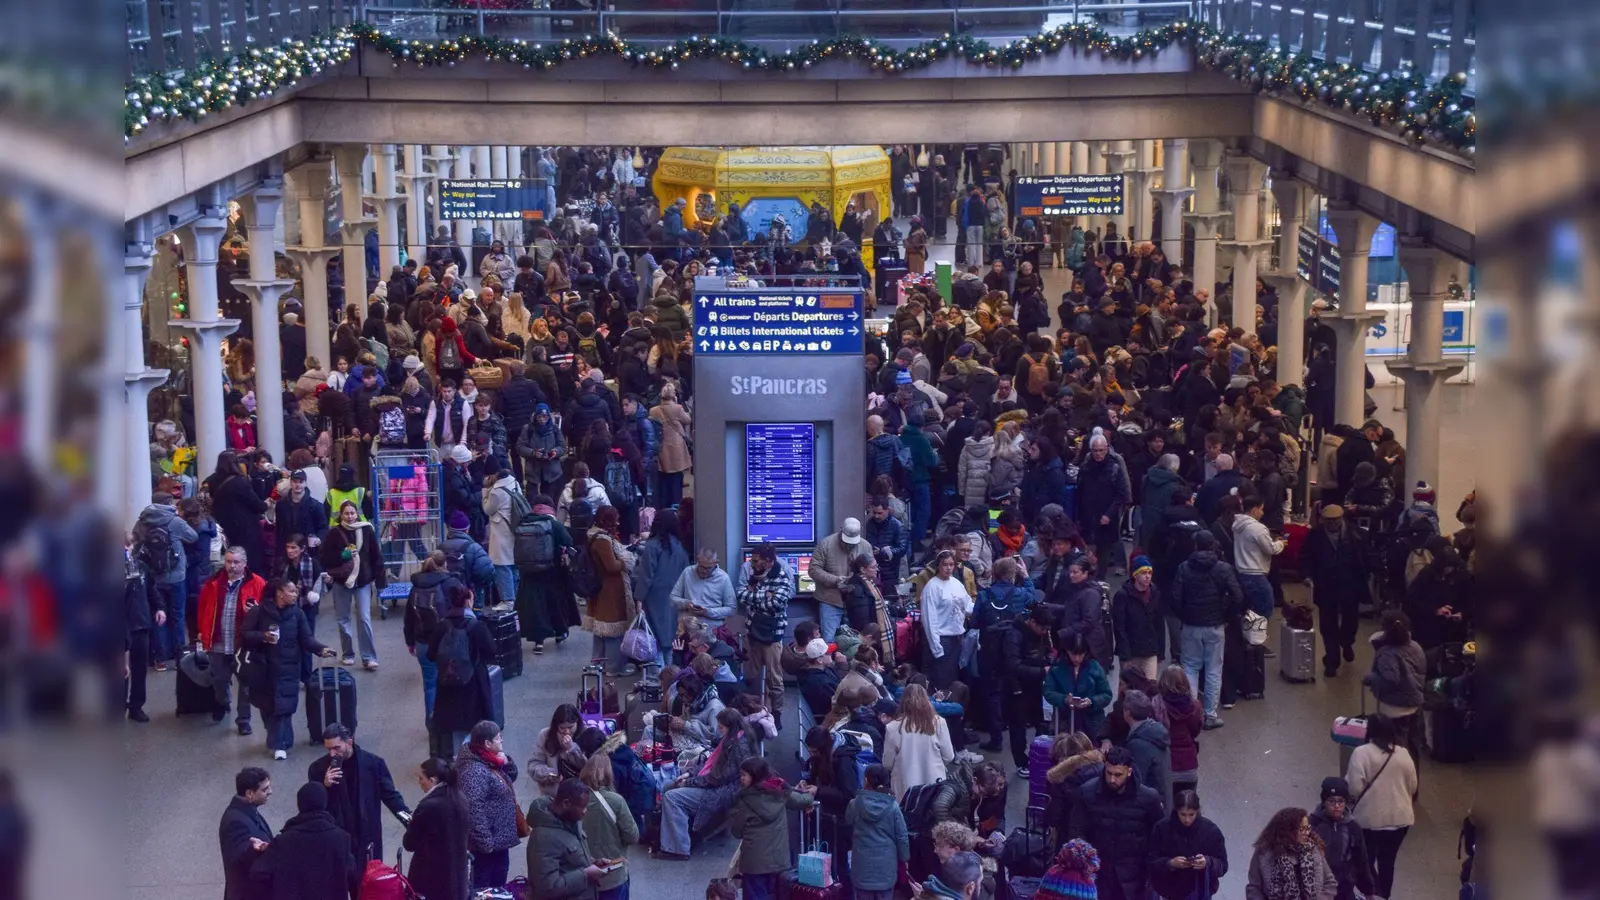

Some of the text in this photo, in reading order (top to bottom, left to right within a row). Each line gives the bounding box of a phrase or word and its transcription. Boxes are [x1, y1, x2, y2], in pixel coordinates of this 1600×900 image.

[714, 297, 756, 306] All trains
[754, 312, 844, 323] Départs Departures
[721, 326, 844, 336] Billets International tickets
